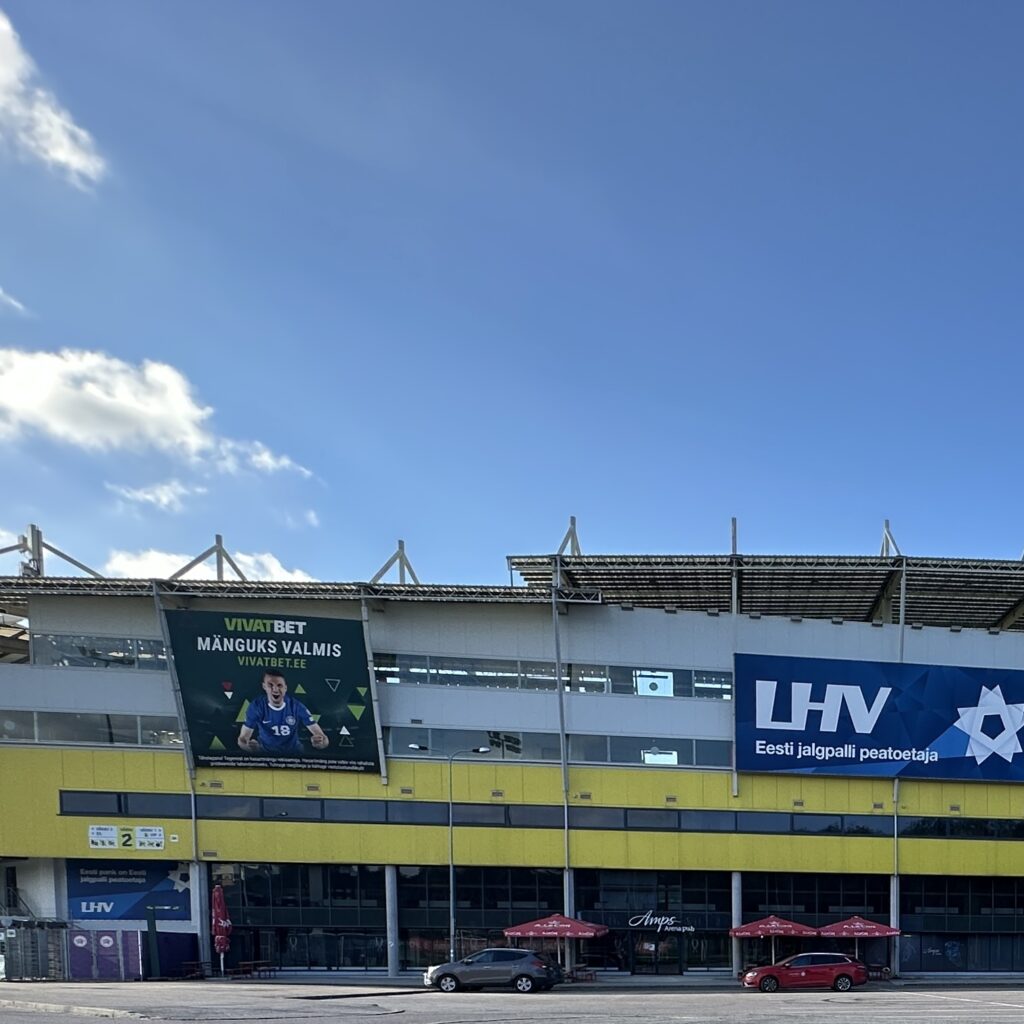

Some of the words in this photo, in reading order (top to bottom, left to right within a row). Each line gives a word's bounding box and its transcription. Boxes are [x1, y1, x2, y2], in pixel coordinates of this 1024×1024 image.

[224, 617, 307, 635] VIVATBET
[197, 634, 278, 654] MÄNGUKS
[281, 640, 342, 657] VALMIS
[238, 656, 307, 669] VIVATBET.EE
[756, 680, 892, 734] LHV
[271, 725, 291, 736] 18
[755, 740, 794, 756] Eesti
[797, 742, 856, 760] jalgpalli
[859, 747, 939, 764] peatoetaja
[121, 833, 133, 847] 2
[81, 902, 114, 913] LHV
[628, 910, 681, 933] Amps
[682, 925, 695, 933] pub
